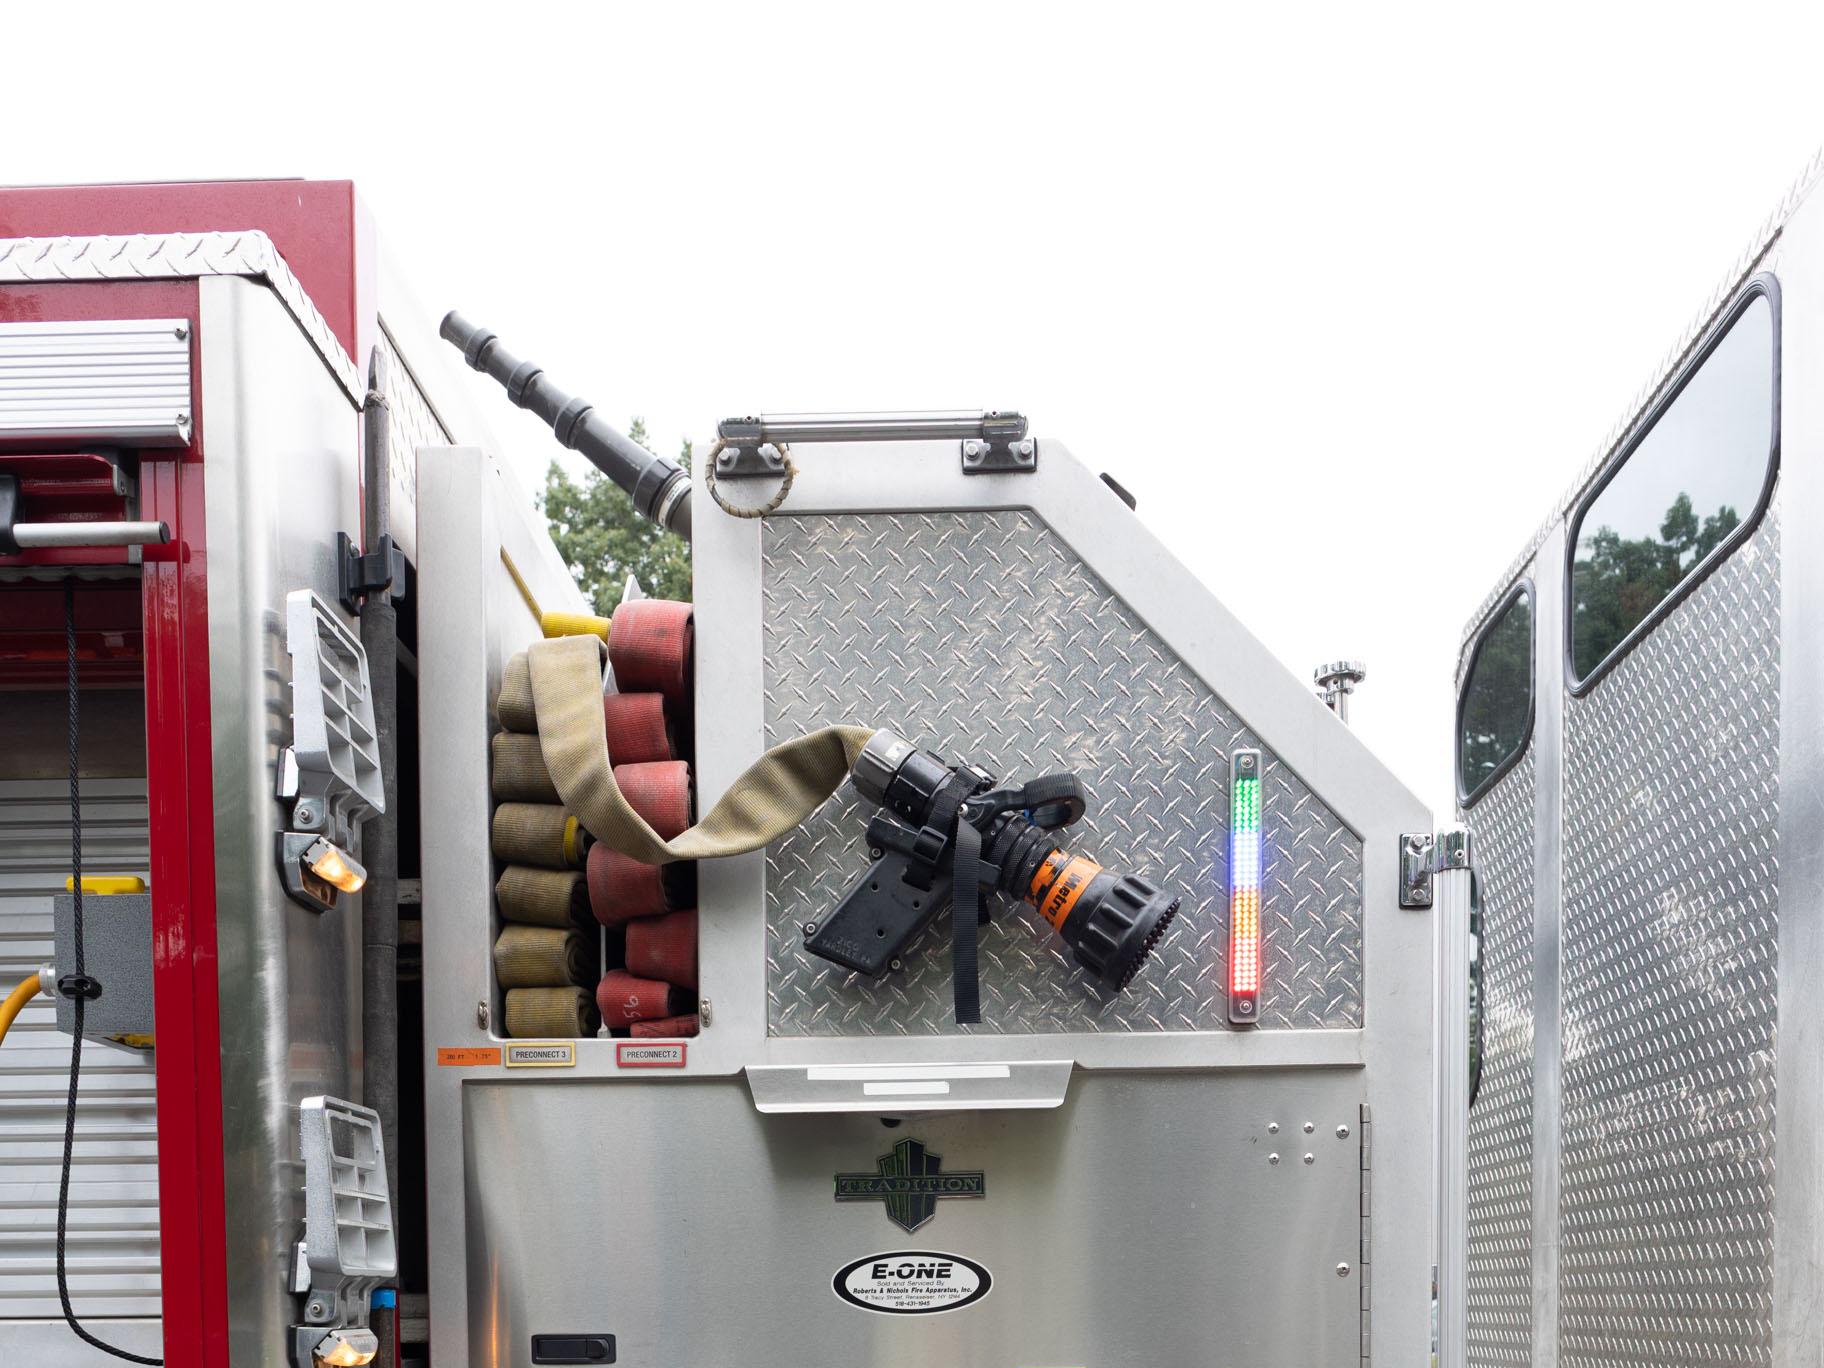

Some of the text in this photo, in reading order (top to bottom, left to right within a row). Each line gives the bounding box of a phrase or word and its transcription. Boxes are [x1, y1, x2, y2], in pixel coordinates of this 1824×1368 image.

[1047, 873, 1083, 917] Metro
[515, 1050, 567, 1059] PRECONNECT 3
[626, 1050, 678, 1059] PRECONNECT 2
[841, 1177, 979, 1192] TRADITION
[871, 1262, 953, 1279] E-ONE
[925, 1286, 959, 1294] Apparatus,
